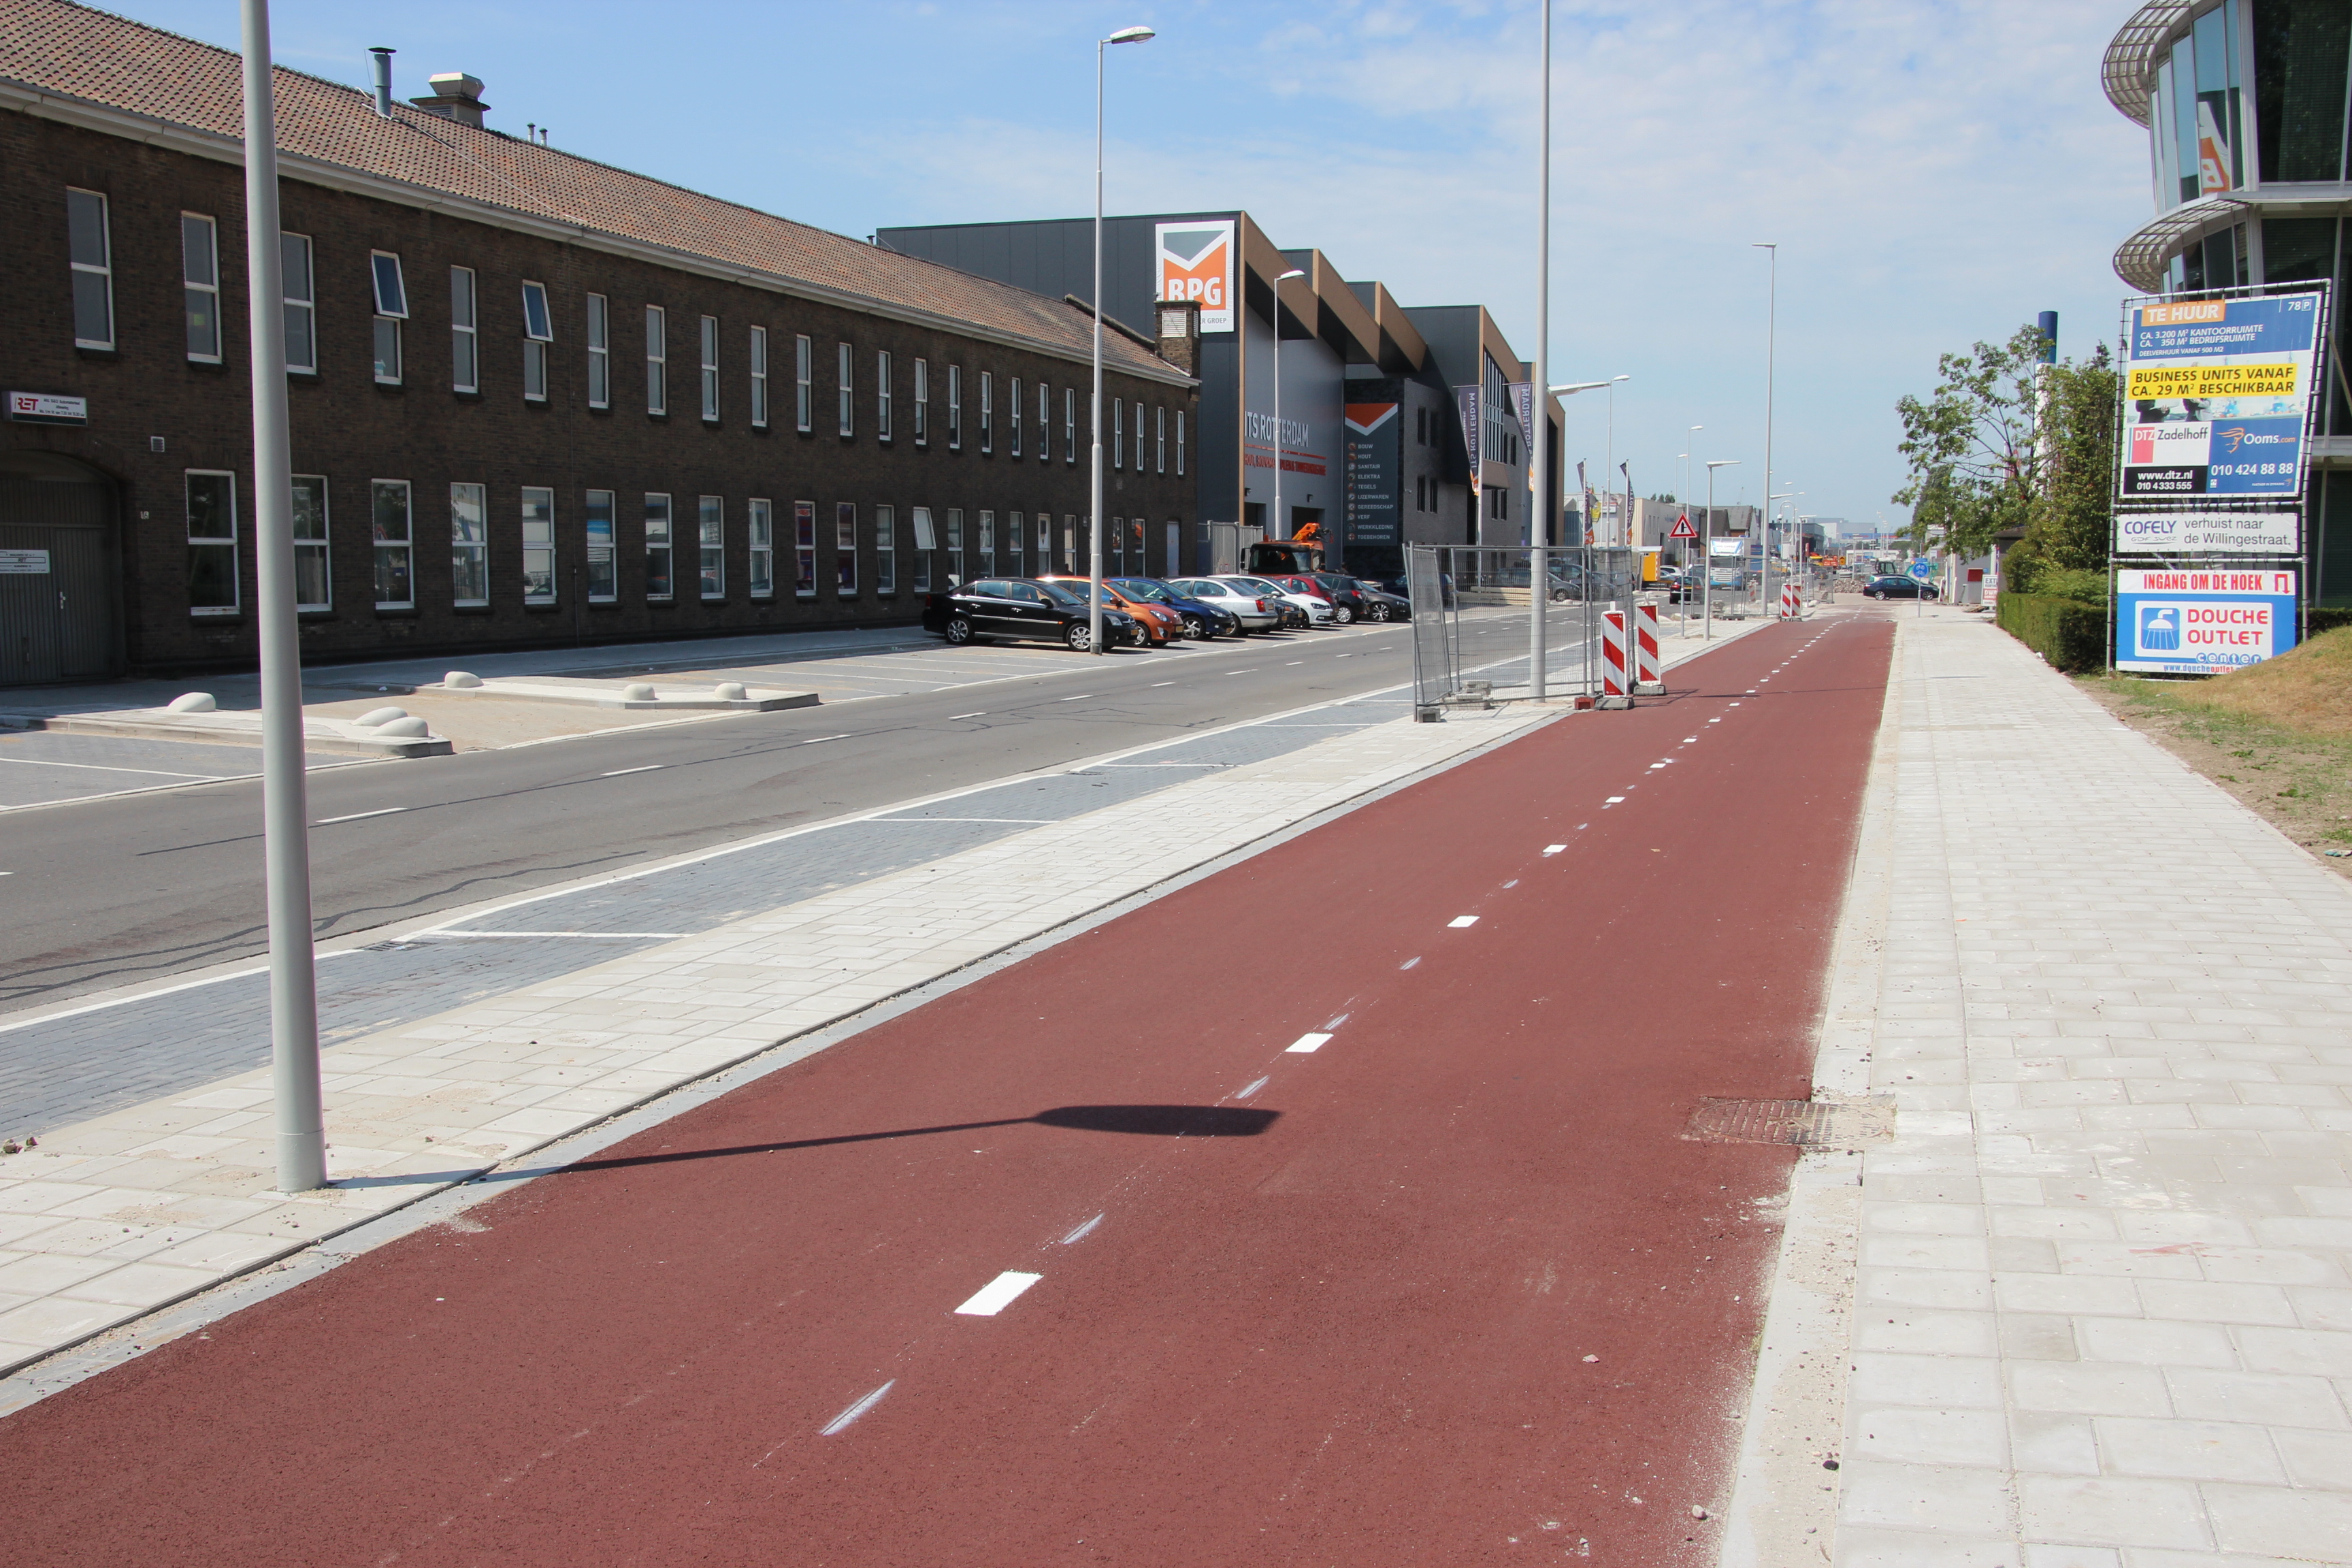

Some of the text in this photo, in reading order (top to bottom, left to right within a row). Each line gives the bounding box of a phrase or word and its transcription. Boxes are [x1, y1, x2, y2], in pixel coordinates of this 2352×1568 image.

[2147, 304, 2219, 323] TE HUUR
[2155, 331, 2176, 339] 3.200
[2191, 325, 2264, 337] KANTOORRUIMTE
[2189, 333, 2255, 345] BEDRIJFSRUIMTE
[2139, 348, 2180, 357] DEELVERHUUR
[2135, 367, 2293, 383] BUSINESS UNITS VANAF
[2132, 385, 2152, 396] CA.
[2157, 385, 2172, 395] 29
[2199, 381, 2294, 394] BESCHIKBAAR
[18, 397, 39, 410] RET
[1245, 411, 1258, 438] ITS
[2135, 427, 2208, 441] DTZ Zadelhoff
[2244, 432, 2296, 445] Ooms.com
[2138, 470, 2193, 480] www.dtz.nl
[2211, 463, 2293, 476] 010 424 88 88
[2137, 482, 2151, 491] 010
[2176, 482, 2192, 490] 555
[2124, 520, 2177, 534] COFELY
[2184, 517, 2264, 529] verhuist naar
[2184, 532, 2291, 547] de Willingestraat.
[2144, 574, 2263, 591] INGANG OM DE HOEK
[2187, 609, 2268, 625] DOUCHE
[2187, 630, 2263, 645] OUTLET
[2198, 653, 2261, 664] center
[2163, 664, 2245, 674] www.doucheoutlet
